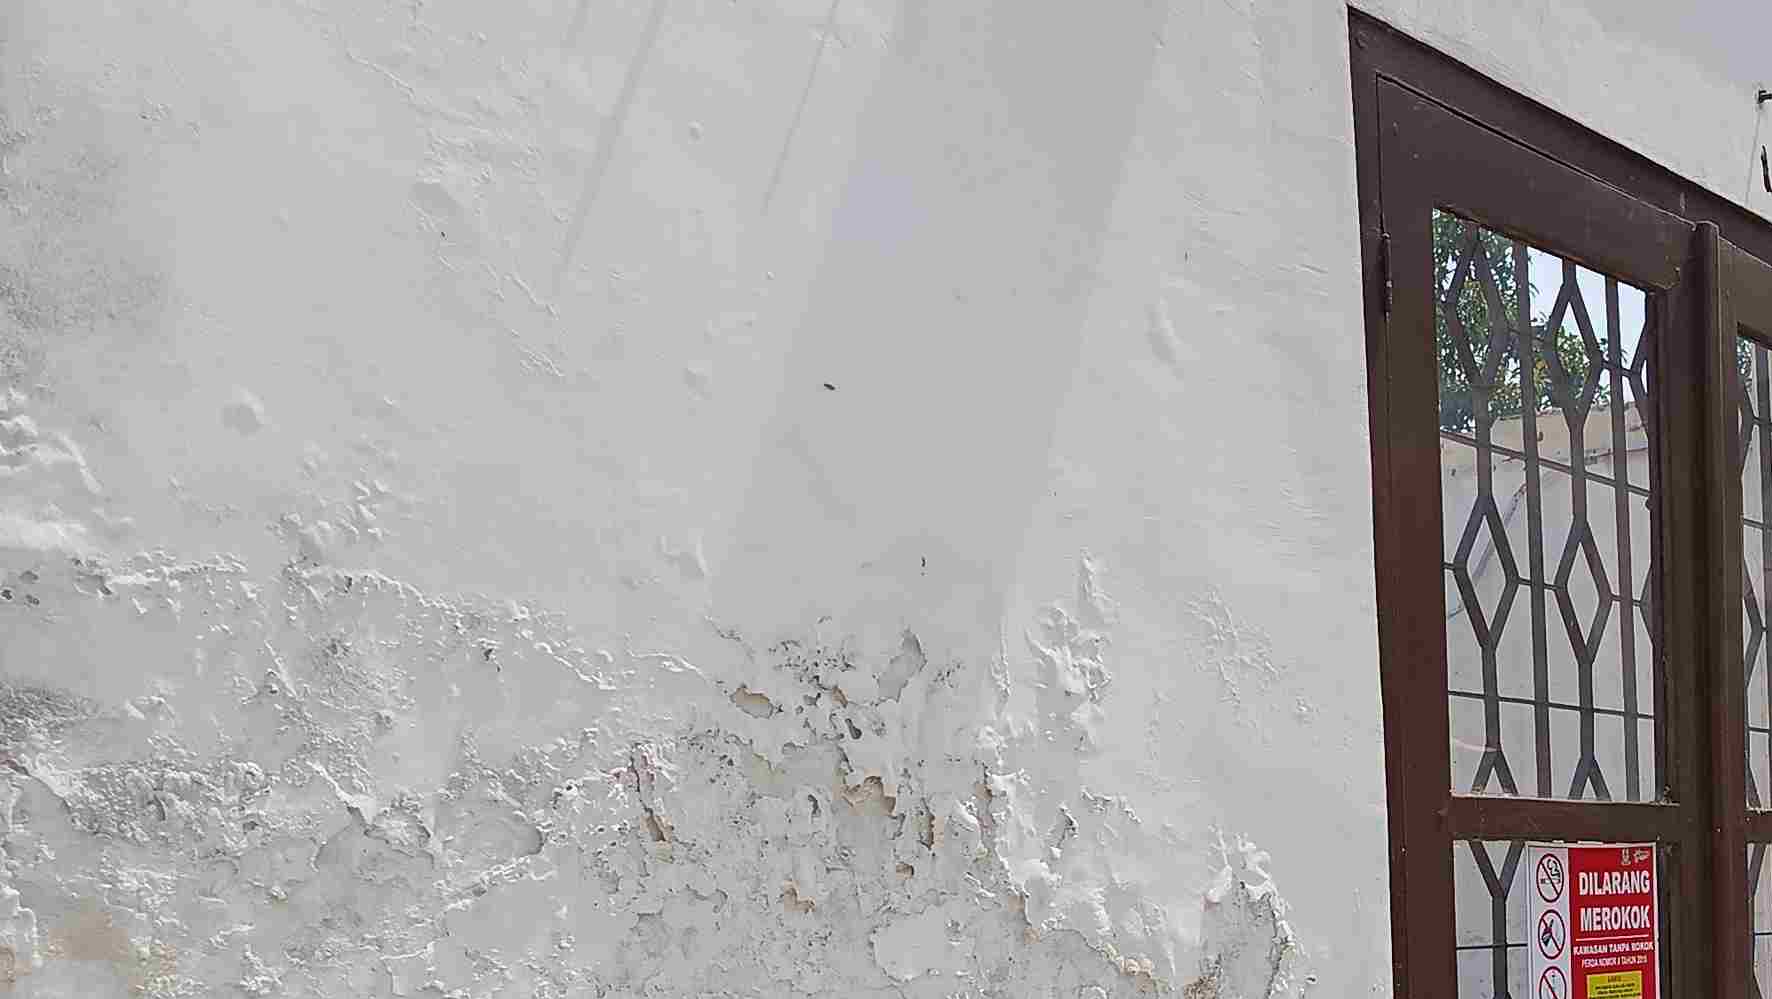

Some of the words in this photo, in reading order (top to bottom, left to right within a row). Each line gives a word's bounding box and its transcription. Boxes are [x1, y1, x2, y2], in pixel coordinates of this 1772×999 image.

[1578, 870, 1650, 896] DILARANG
[1580, 905, 1651, 932] MEROKOK
[1573, 944, 1608, 955] KAWASAN
